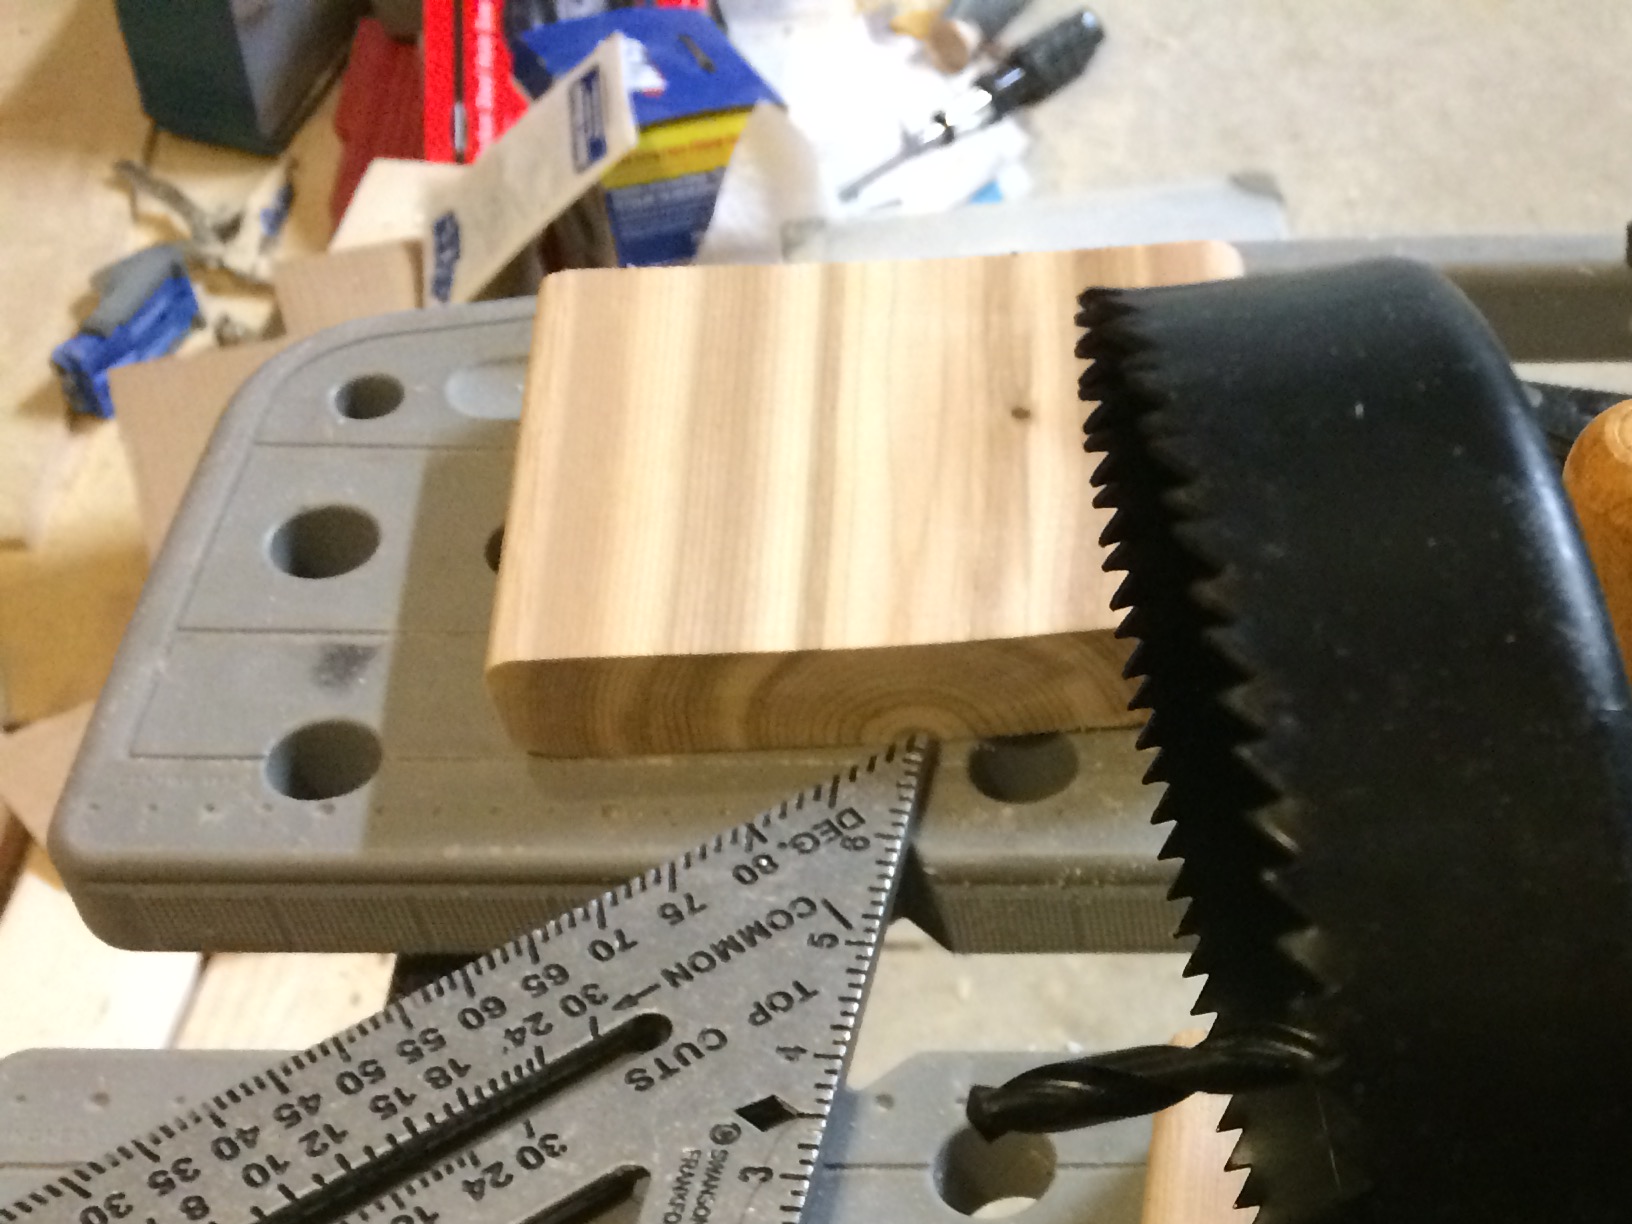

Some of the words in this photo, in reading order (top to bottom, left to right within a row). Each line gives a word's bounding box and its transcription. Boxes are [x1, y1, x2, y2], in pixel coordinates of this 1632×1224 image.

[732, 853, 779, 886] 80
[657, 892, 708, 927] 75
[587, 928, 639, 962] 70
[660, 896, 817, 989] COMMON
[521, 963, 570, 998] 65
[458, 995, 508, 1031] 60
[559, 983, 610, 1018] 30
[748, 980, 820, 1027] TOP
[396, 1027, 447, 1065] 55
[504, 1010, 554, 1049] 24
[335, 1058, 387, 1096] 50
[423, 1057, 472, 1091] 18
[624, 1027, 728, 1092] CUTS
[273, 1092, 323, 1129] 45
[369, 1086, 418, 1121] 15
[210, 1125, 260, 1161] 40
[299, 1123, 349, 1158] 12
[515, 1133, 568, 1171] 30
[148, 1157, 200, 1197] 35
[241, 1154, 291, 1188] 10
[461, 1160, 515, 1202] 24
[738, 1165, 774, 1184] 3
[179, 1195, 210, 1221] 8
